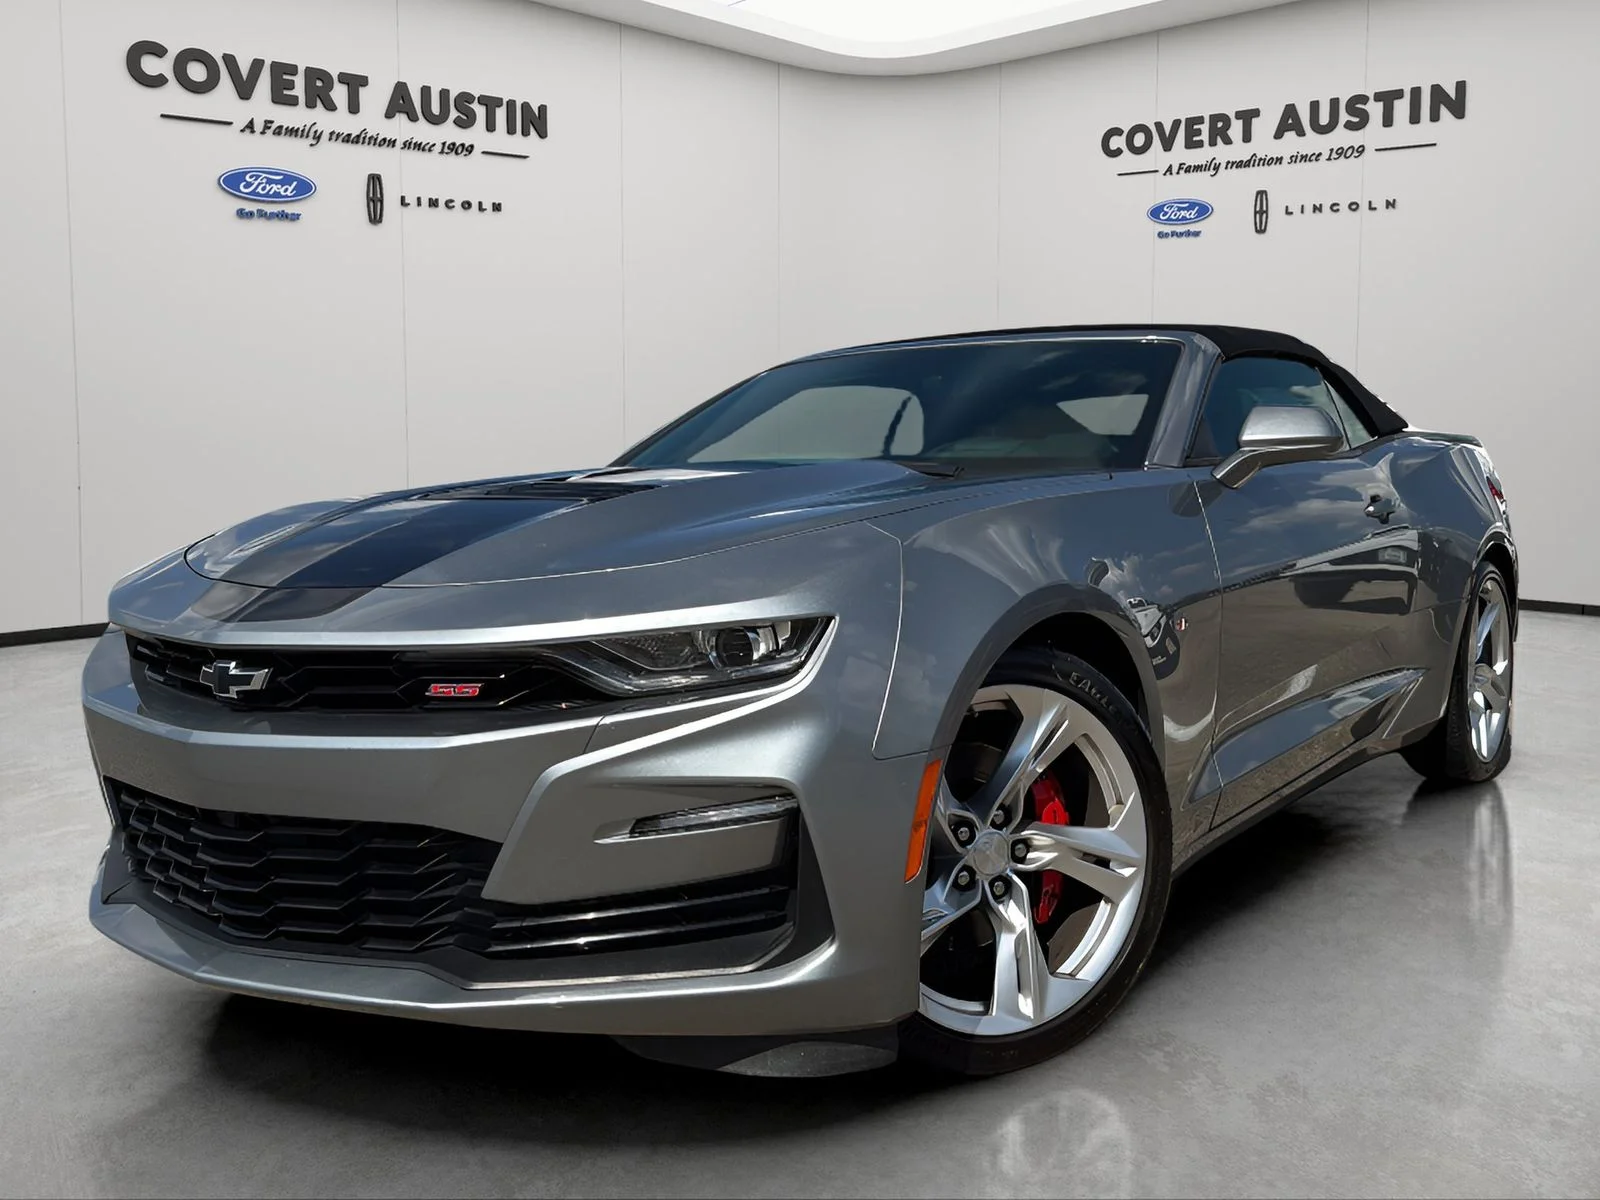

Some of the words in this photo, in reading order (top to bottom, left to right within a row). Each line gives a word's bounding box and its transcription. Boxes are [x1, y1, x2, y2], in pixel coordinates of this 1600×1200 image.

[125, 39, 369, 114] COVERT
[384, 80, 549, 140] AUSTIN
[1100, 108, 1261, 159] COVERT
[1273, 80, 1467, 140] AUSTIN
[240, 117, 256, 134] A
[260, 119, 324, 147] Family
[328, 128, 397, 149] tradition
[400, 137, 436, 153] since
[438, 140, 475, 157] 1909
[1163, 163, 1174, 176] A
[1176, 156, 1221, 177] Family
[1224, 153, 1283, 171] tradition
[1287, 151, 1323, 165] since
[1325, 144, 1366, 162] 1909
[240, 171, 298, 197] Ford
[400, 194, 503, 213] LINCOLN
[1160, 203, 1199, 220] Ford
[1285, 198, 1397, 216] LINCOLN
